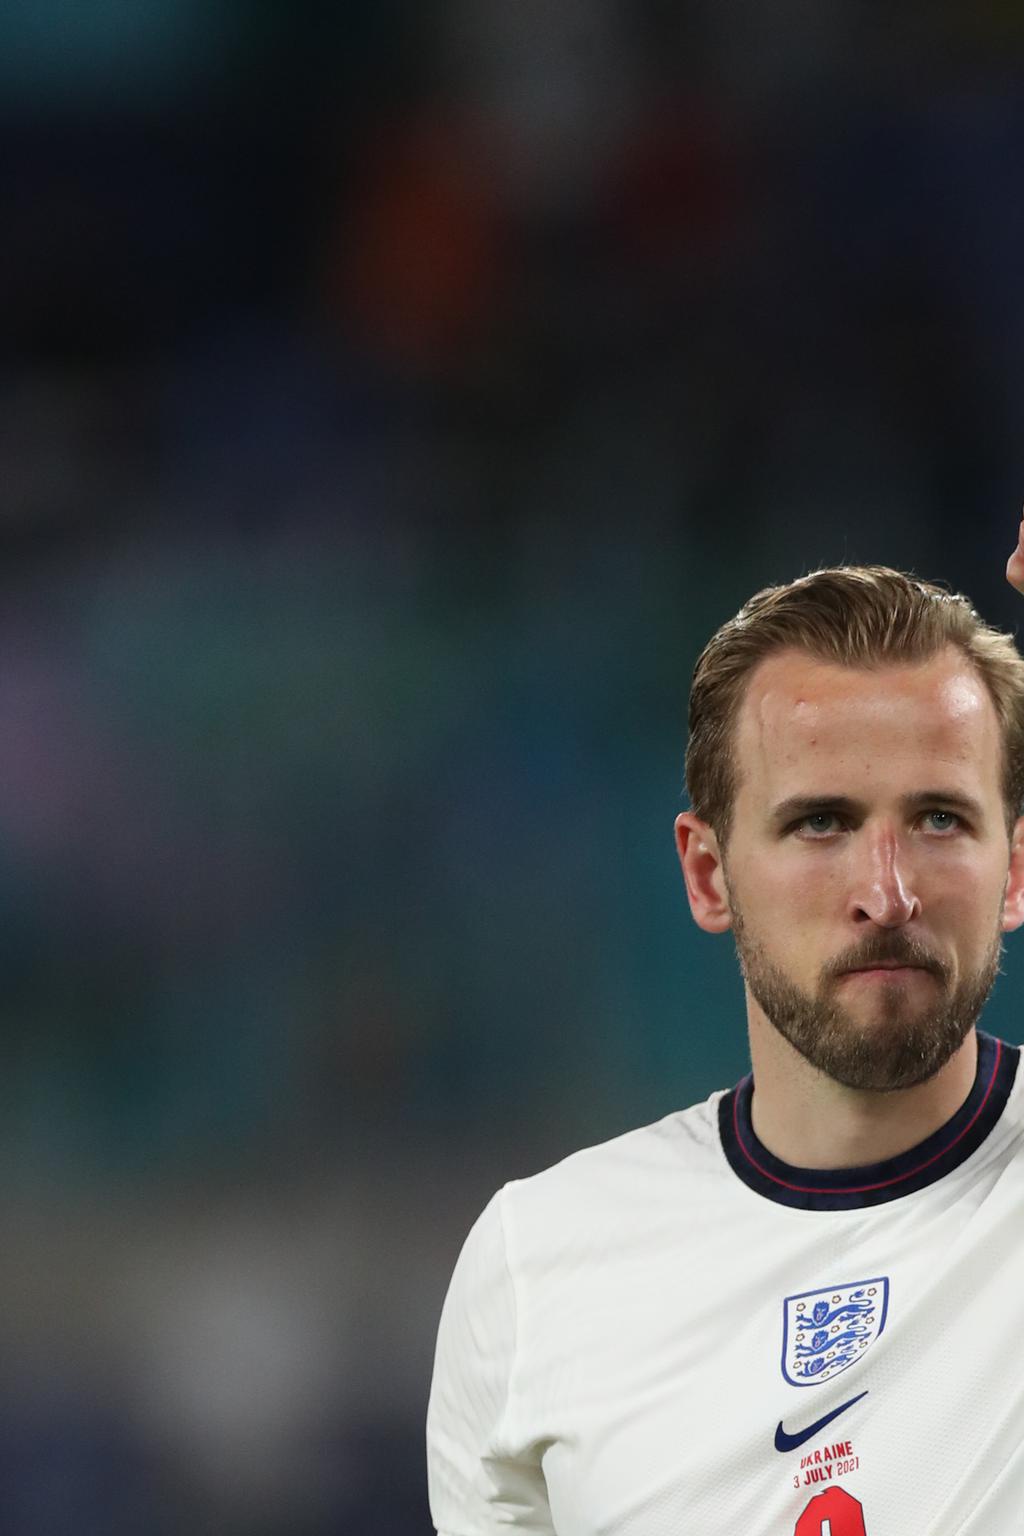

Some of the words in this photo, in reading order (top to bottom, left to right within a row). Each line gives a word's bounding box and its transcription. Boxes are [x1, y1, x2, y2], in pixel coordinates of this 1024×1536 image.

[800, 1441, 853, 1469] UKRAINE
[793, 1475, 800, 1488] 3
[804, 1465, 833, 1485] JULY
[837, 1456, 859, 1476] 2021
